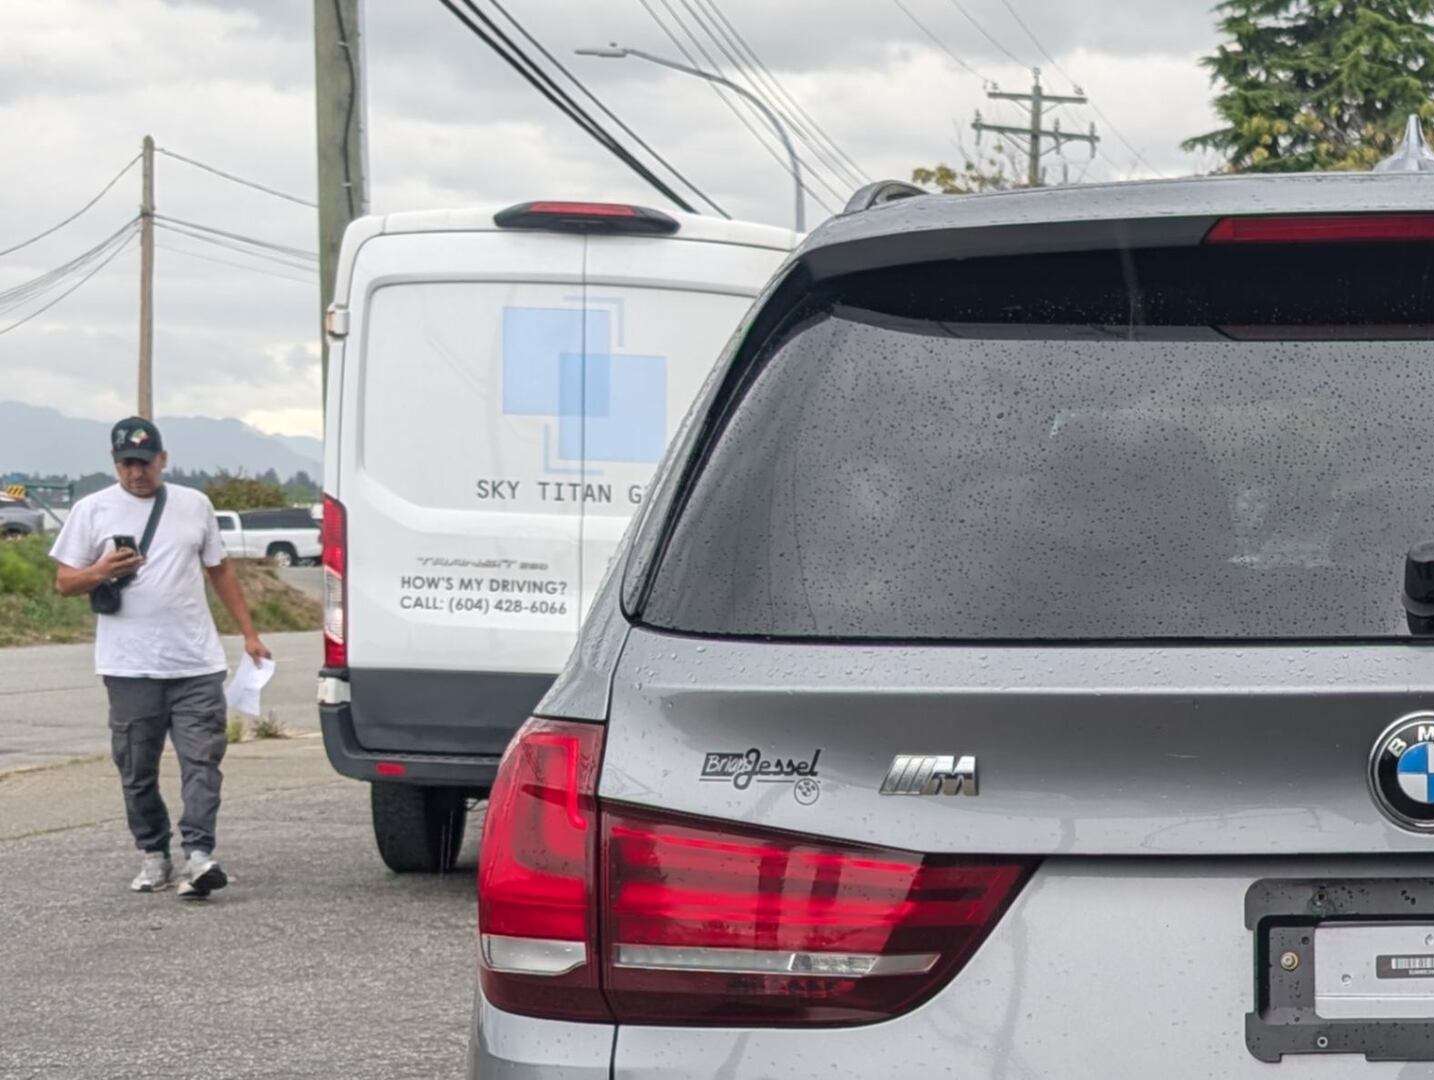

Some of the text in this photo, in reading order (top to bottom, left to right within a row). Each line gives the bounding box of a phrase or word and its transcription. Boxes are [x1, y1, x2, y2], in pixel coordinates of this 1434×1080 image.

[476, 479, 648, 504] SKY TITAN G
[400, 576, 568, 595] HOW'S MY DRIVING?
[400, 595, 567, 615] CALL: (604) 428-6066
[733, 748, 821, 790] Jessel
